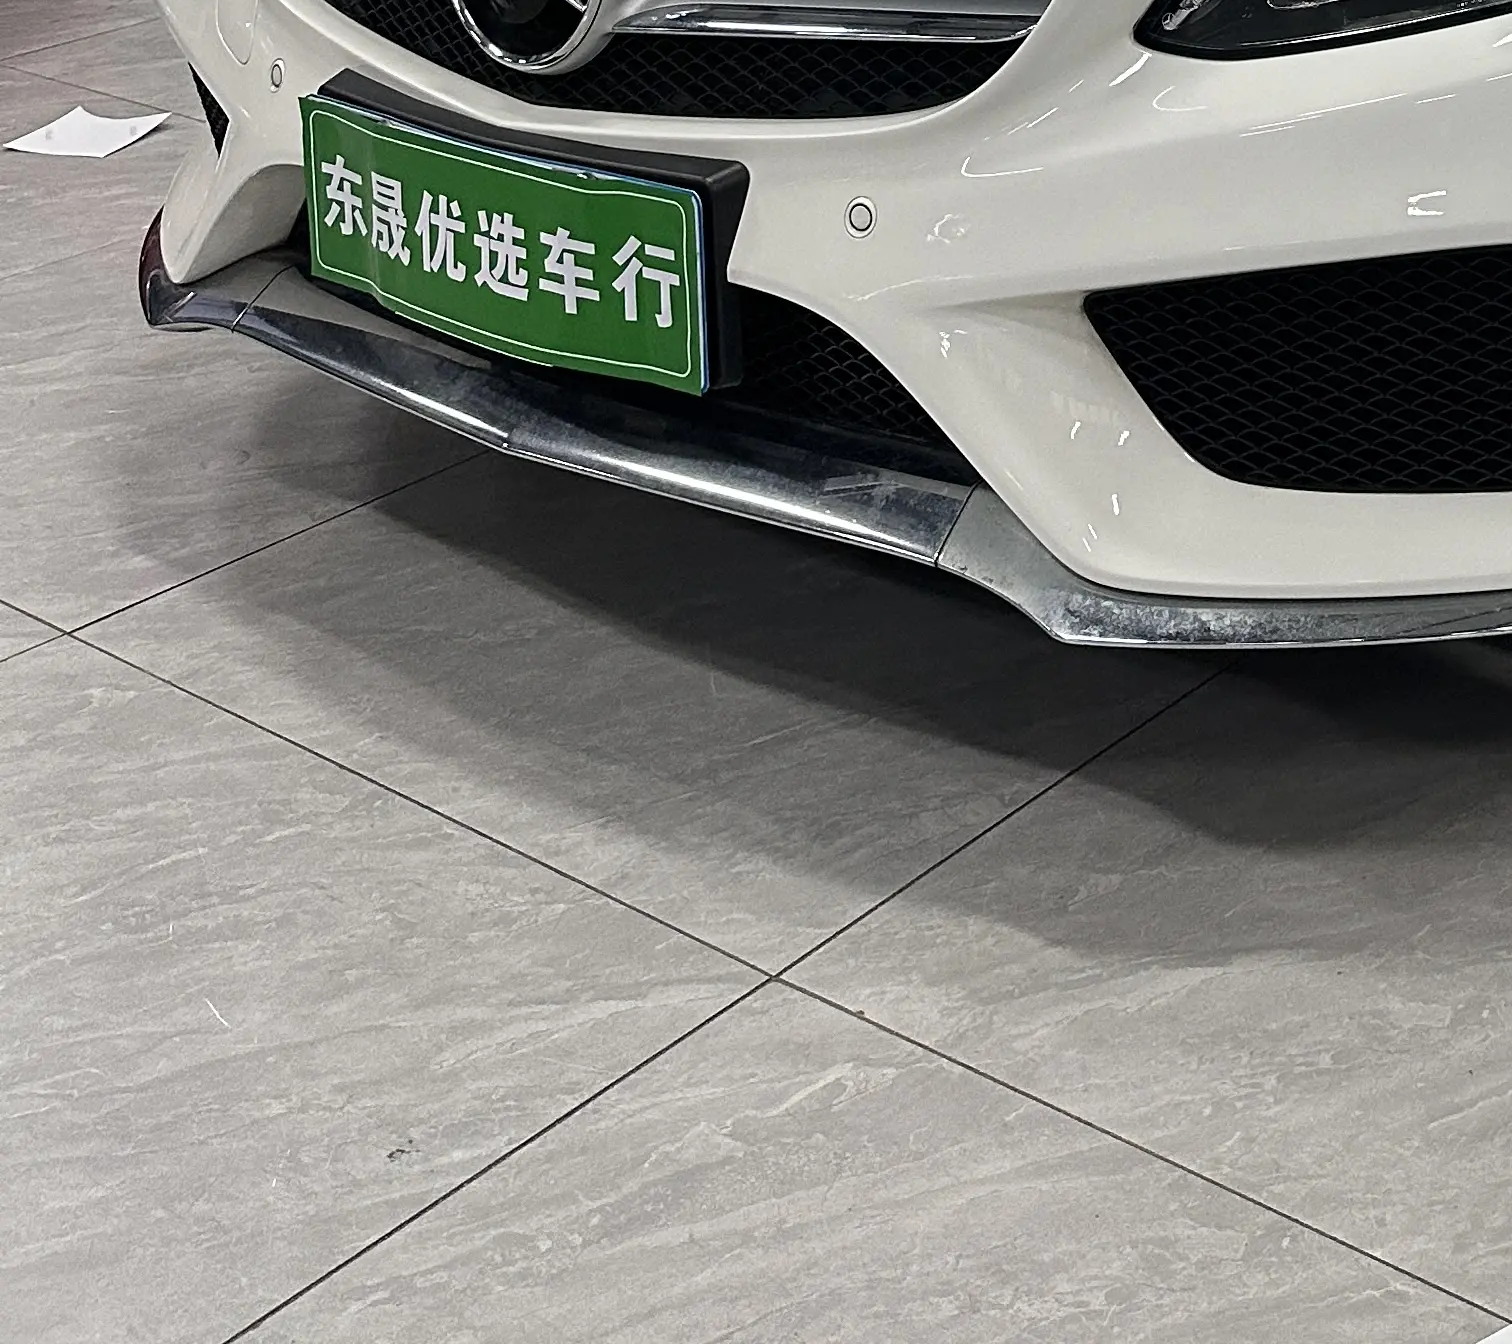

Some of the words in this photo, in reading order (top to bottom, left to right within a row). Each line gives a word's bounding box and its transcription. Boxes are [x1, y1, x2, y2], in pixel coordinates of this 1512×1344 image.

[320, 153, 681, 330] 东晟优选车行
